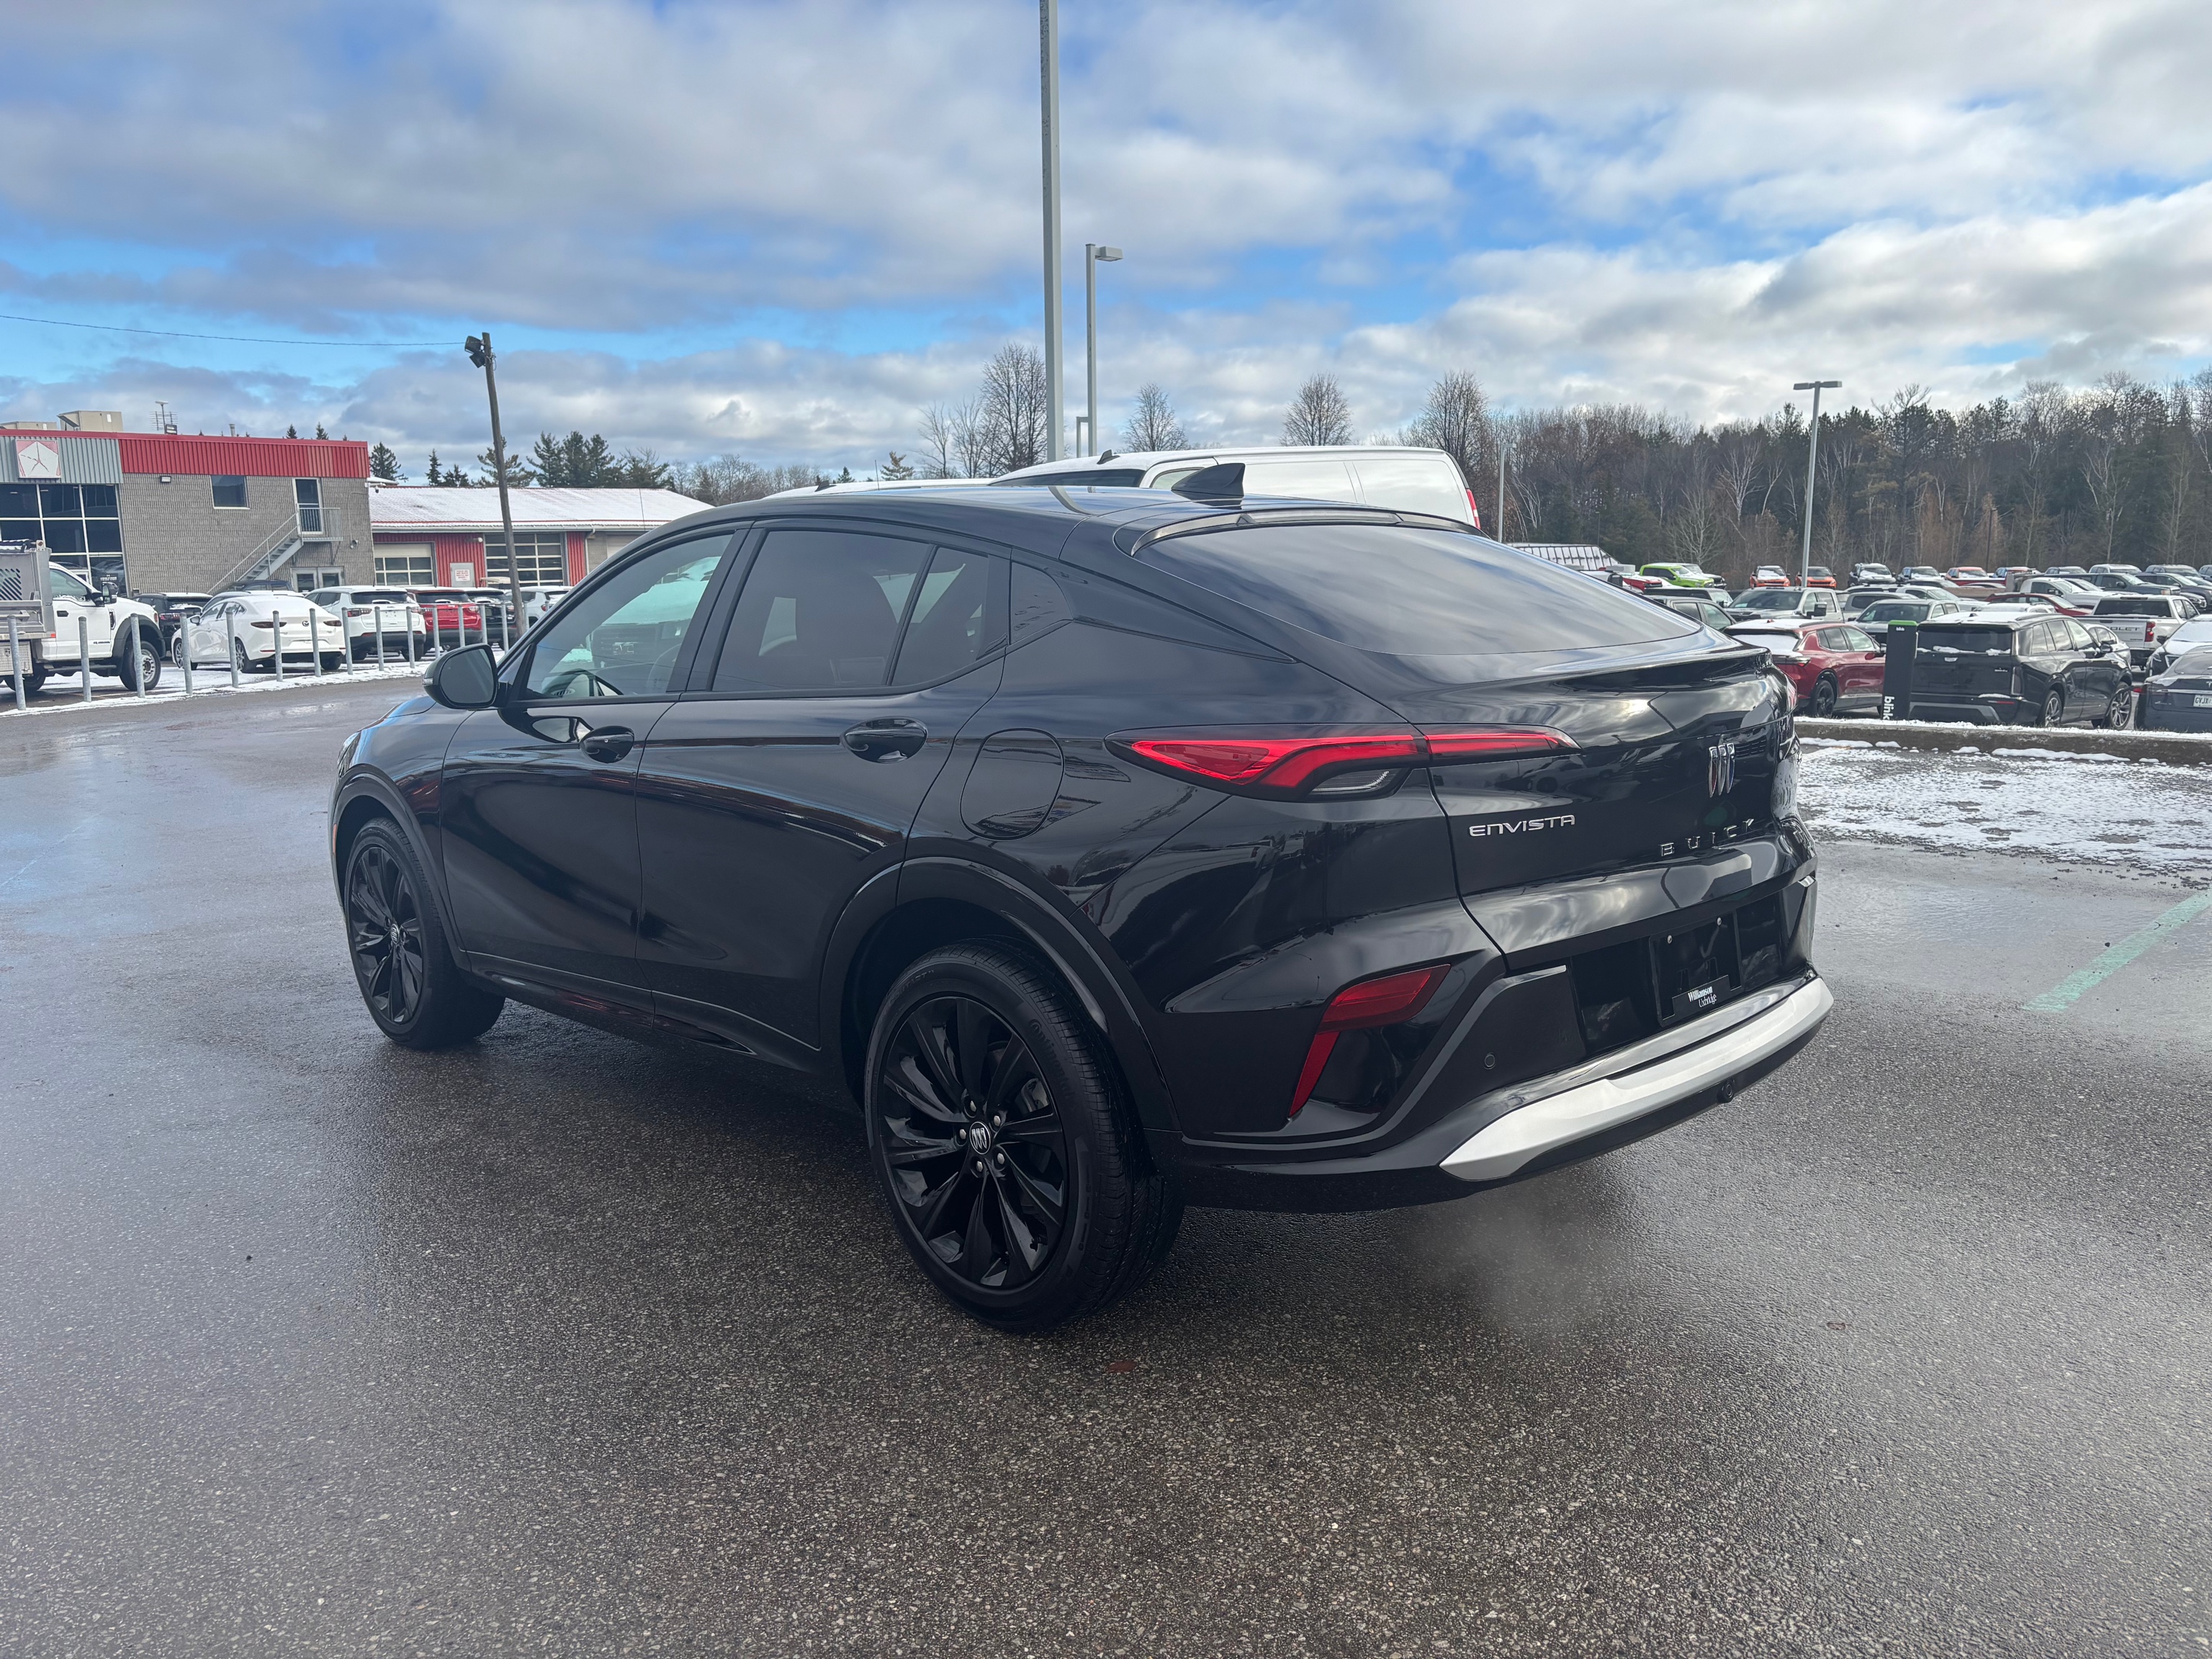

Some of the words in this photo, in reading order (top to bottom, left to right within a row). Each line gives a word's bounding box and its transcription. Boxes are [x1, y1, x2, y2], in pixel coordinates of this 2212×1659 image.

[1883, 696, 1895, 720] blink
[1469, 814, 1575, 837] ENVISTA
[1658, 818, 1755, 857] BUICK
[1688, 986, 1713, 1002] Williamson
[1699, 994, 1717, 1007] Uxbridge
